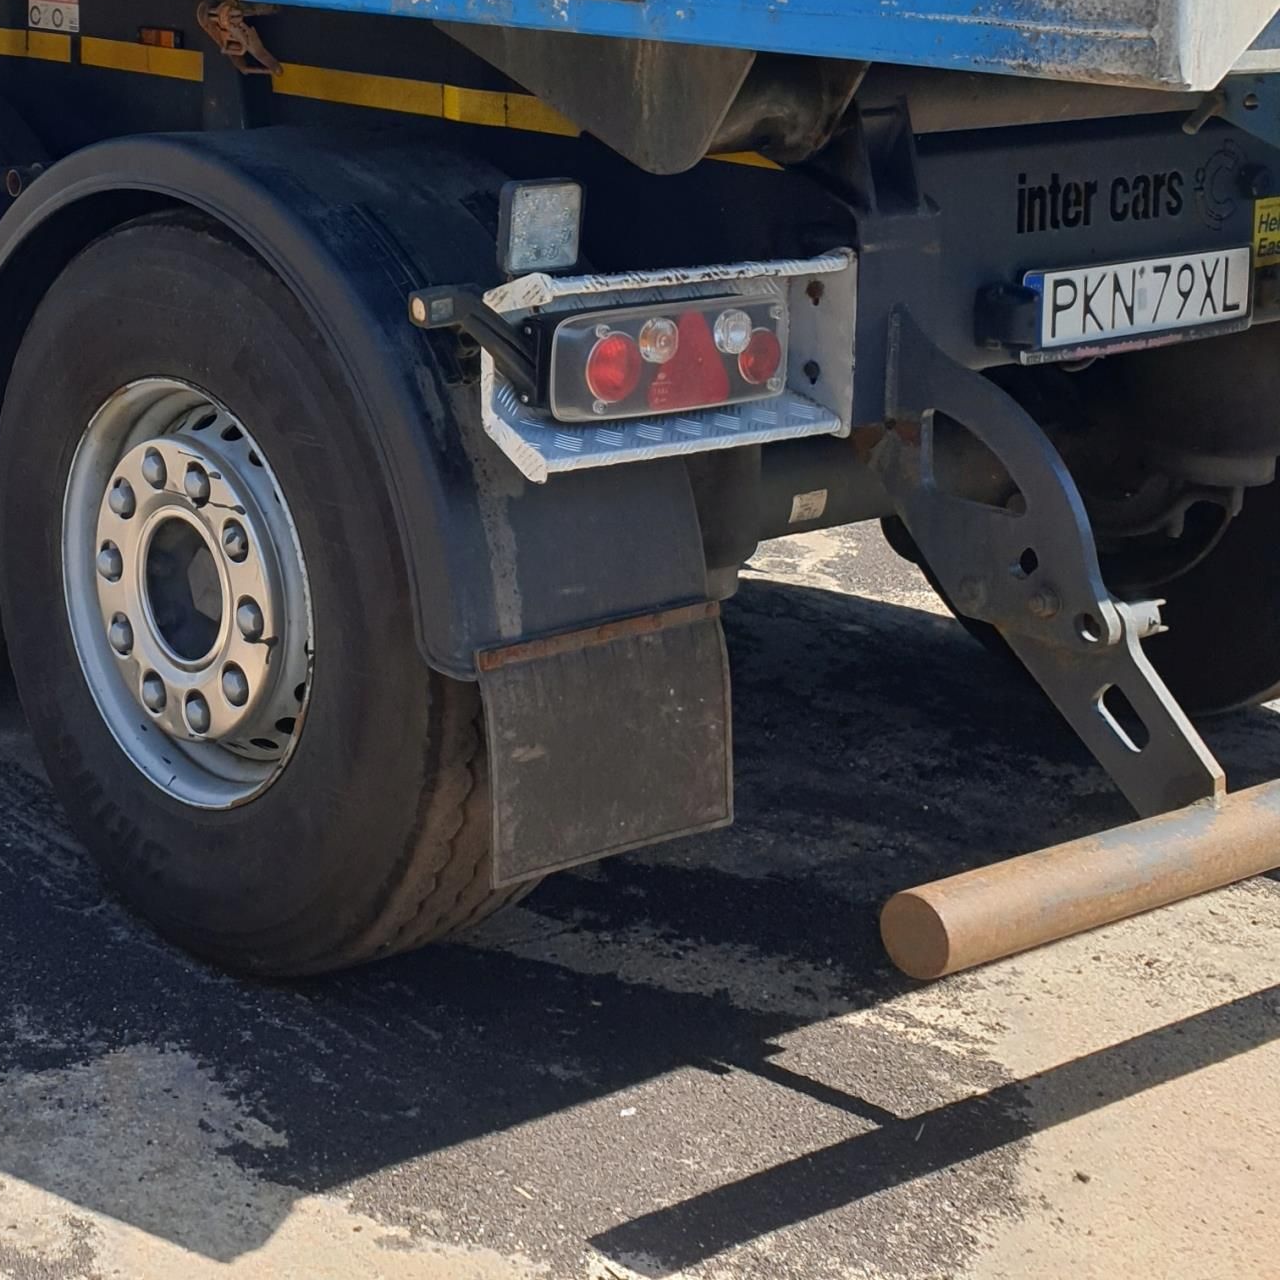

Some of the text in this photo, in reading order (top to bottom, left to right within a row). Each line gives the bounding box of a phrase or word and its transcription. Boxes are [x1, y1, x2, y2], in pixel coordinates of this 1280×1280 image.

[1016, 171, 1184, 234] inter cars
[1051, 257, 1240, 339] PKN 79XL
